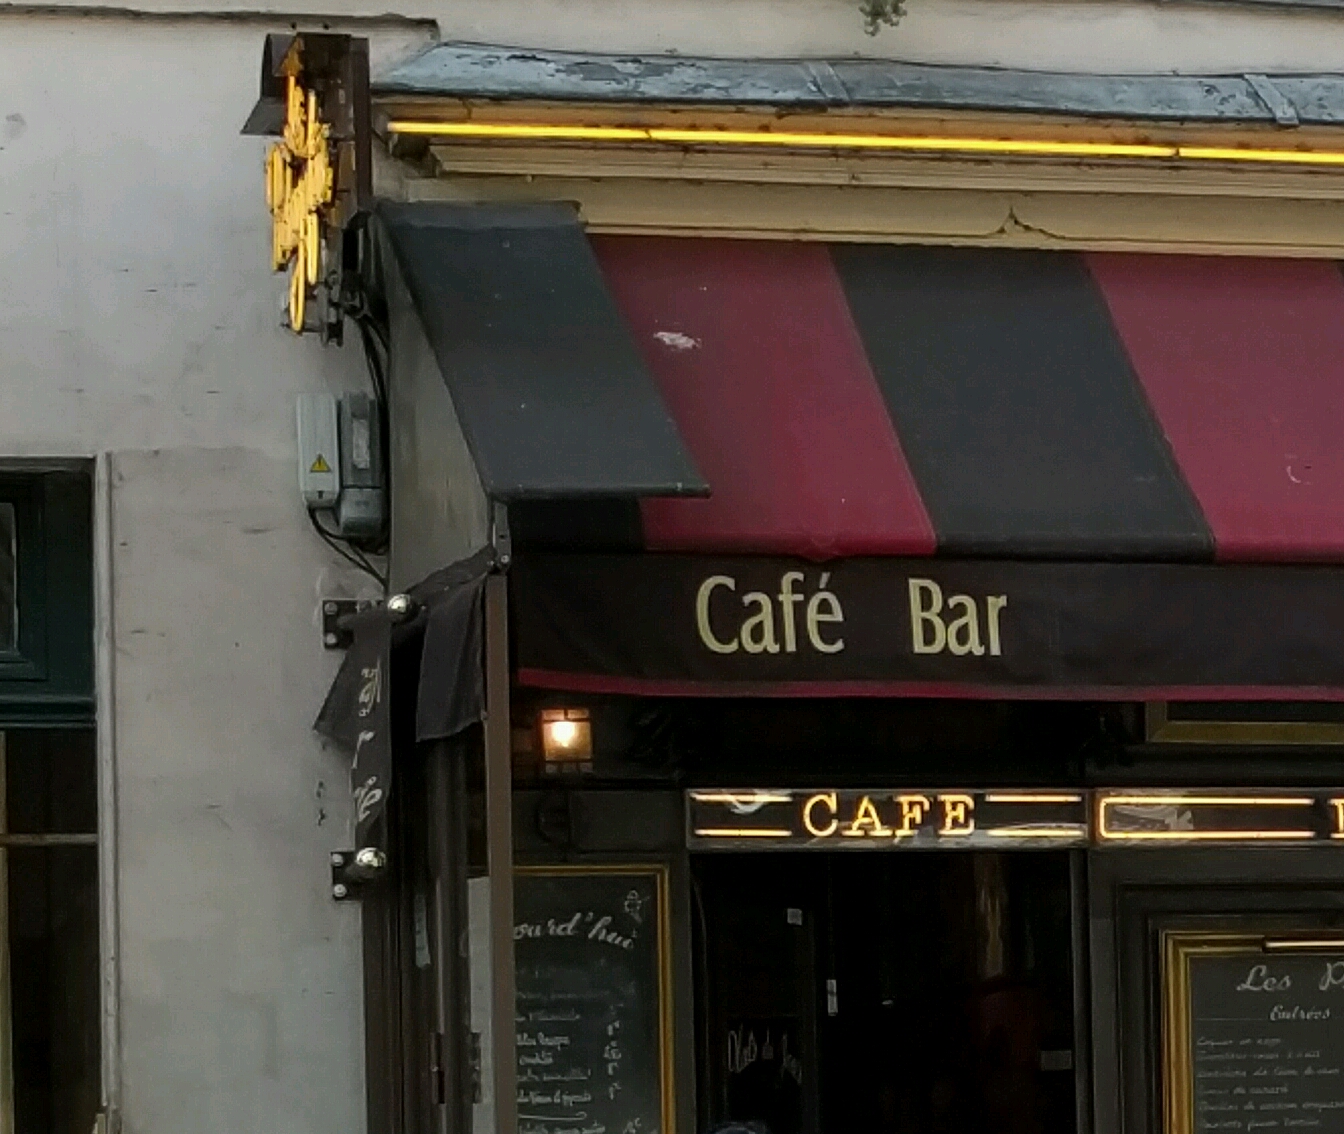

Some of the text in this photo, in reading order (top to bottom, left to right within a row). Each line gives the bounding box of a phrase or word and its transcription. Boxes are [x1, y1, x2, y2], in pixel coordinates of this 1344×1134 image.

[696, 571, 1008, 656] Café Bar
[803, 793, 976, 838] CAFE
[1236, 964, 1292, 992] Les
